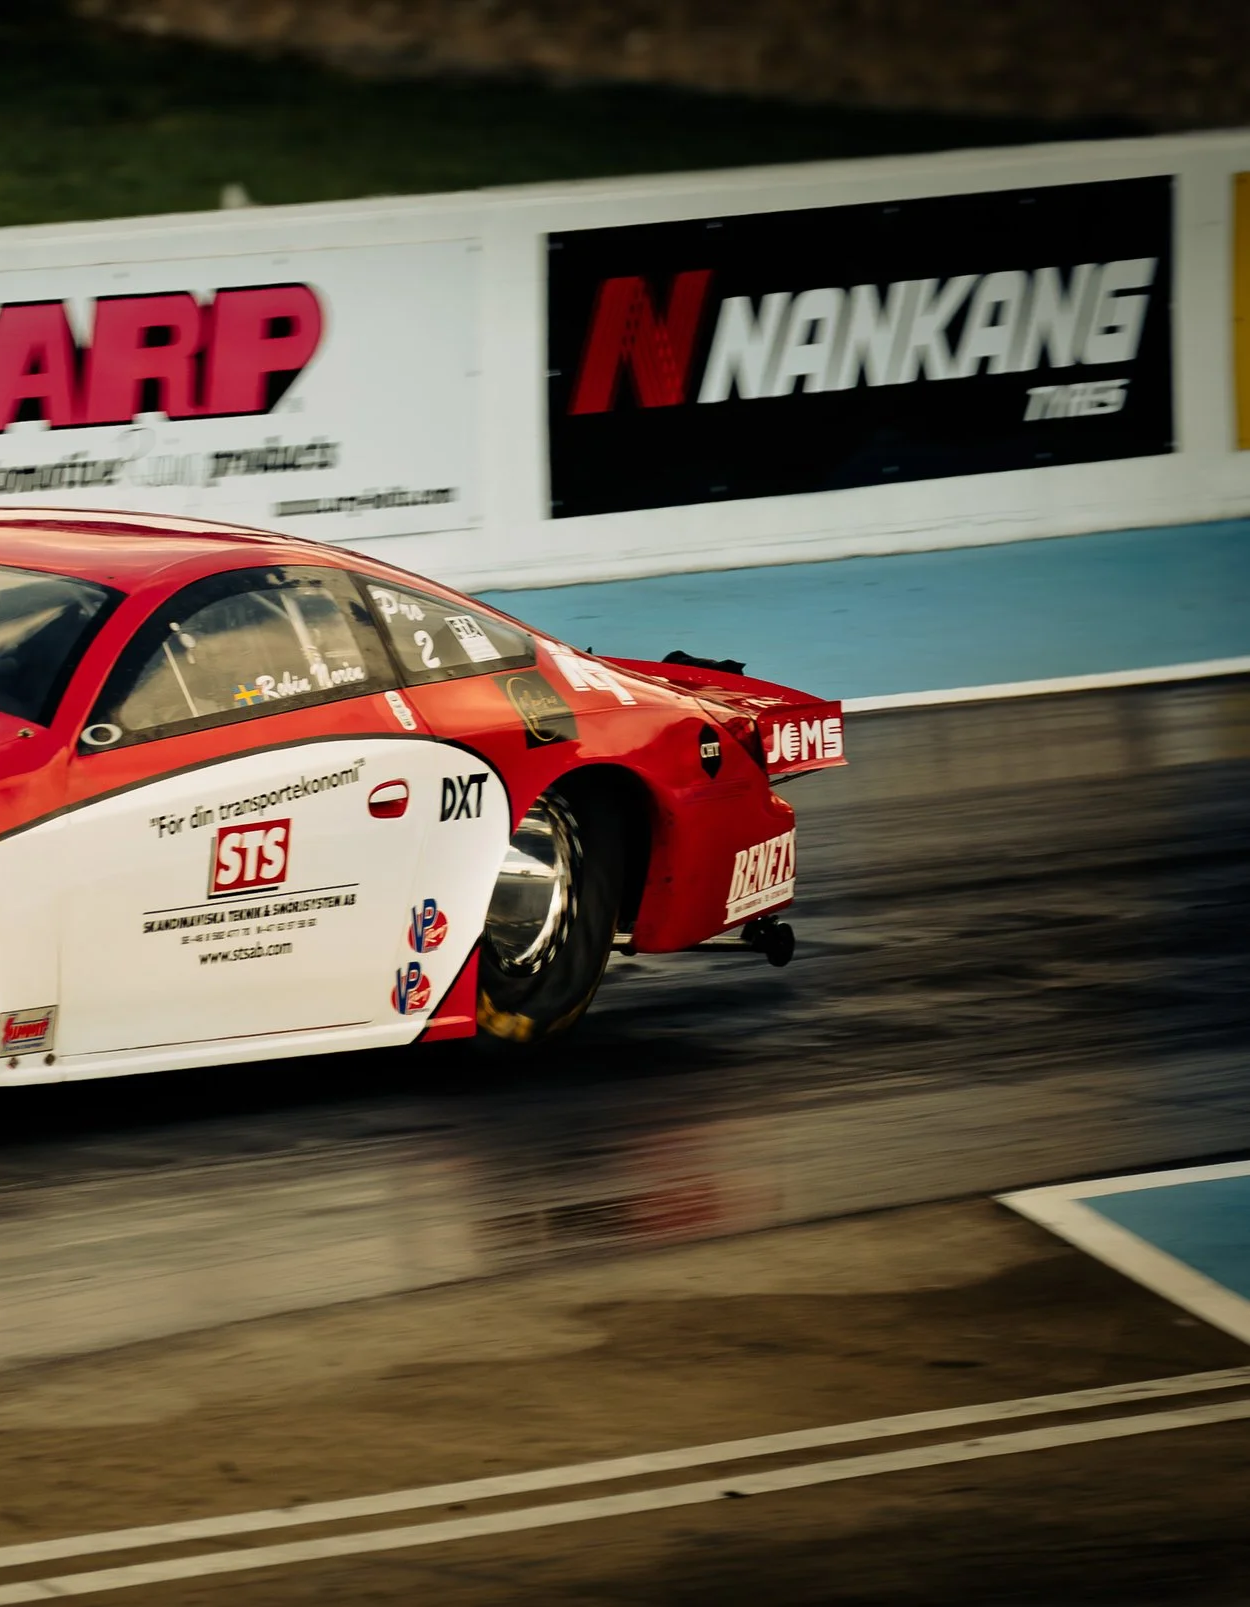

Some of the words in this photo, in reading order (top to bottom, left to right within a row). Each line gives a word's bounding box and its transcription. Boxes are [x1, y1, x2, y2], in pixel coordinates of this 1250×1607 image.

[696, 258, 1158, 404] NANKANG
[413, 630, 441, 669] 2
[438, 772, 490, 822] DXT
[190, 805, 215, 829] din
[215, 826, 288, 886] STS
[228, 907, 261, 922] TEKNIK
[198, 941, 293, 965] www.stsab.com
